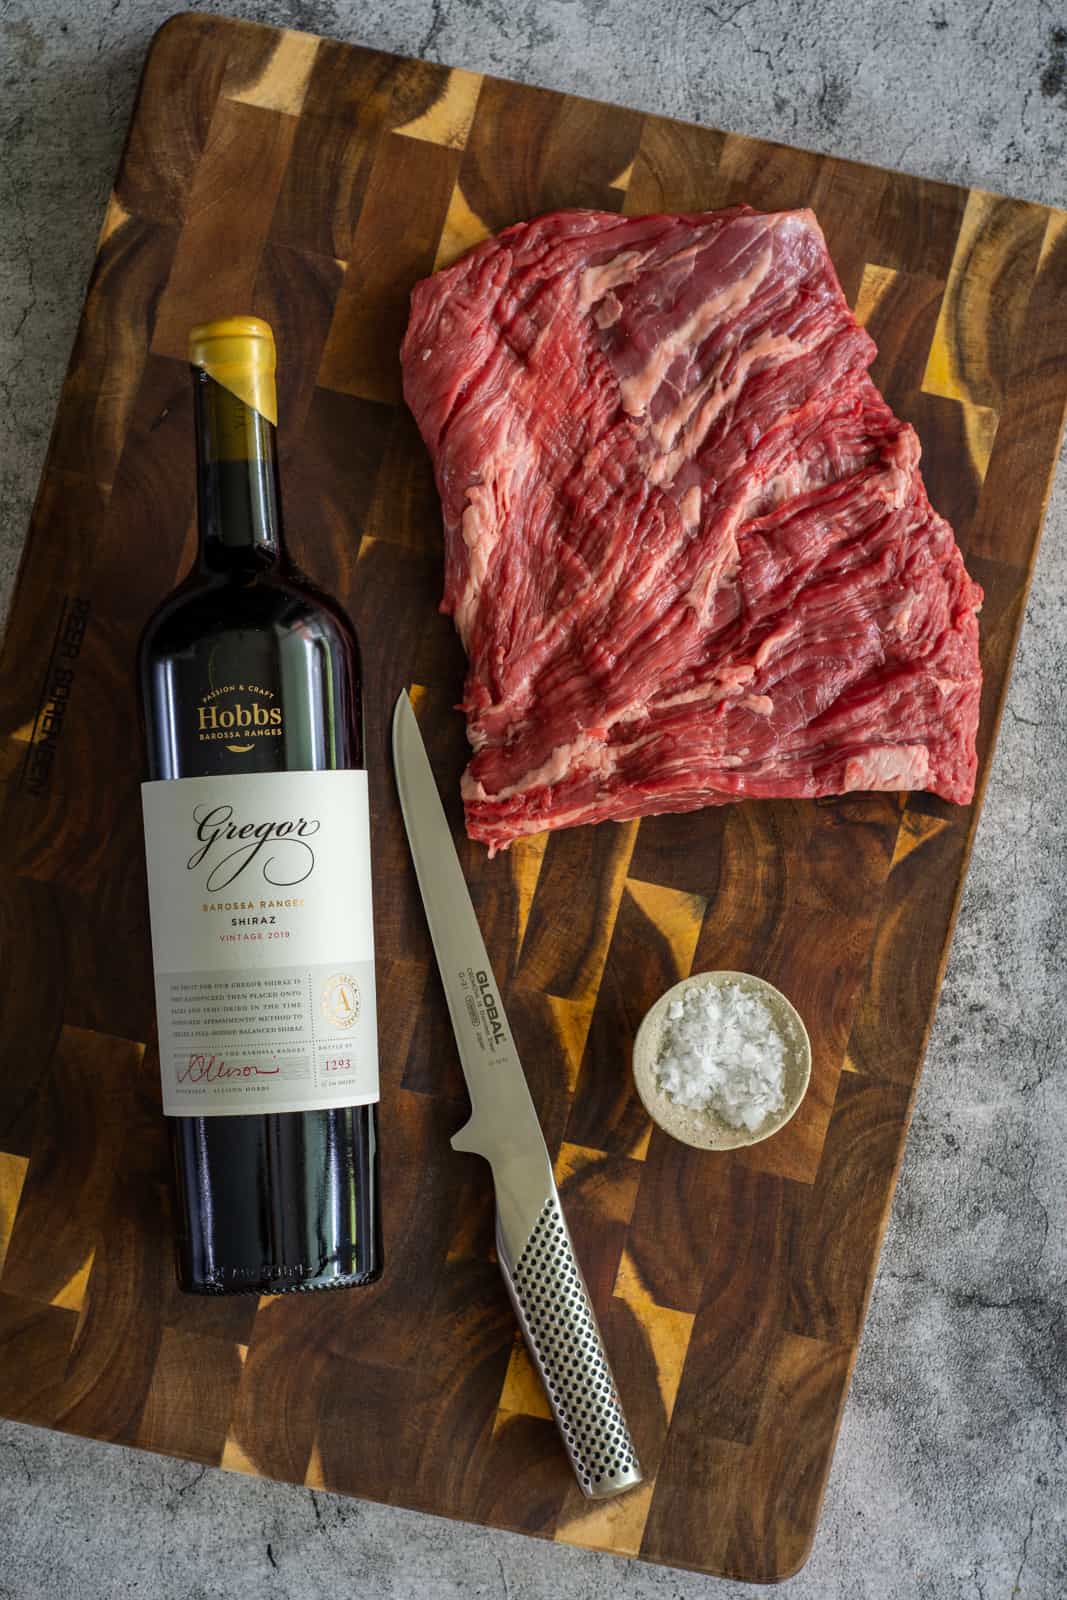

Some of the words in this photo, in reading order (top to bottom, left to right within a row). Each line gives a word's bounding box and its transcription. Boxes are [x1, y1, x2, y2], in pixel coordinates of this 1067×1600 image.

[203, 685, 235, 703] PASSION
[248, 685, 275, 699] CRAFT
[197, 703, 282, 730] Hobbs
[199, 731, 240, 741] BAROSSA
[244, 728, 282, 737] RANGES
[187, 802, 320, 892] Gregor
[203, 902, 255, 912] BAROSSA
[231, 915, 276, 926] SHIRAZ
[219, 932, 263, 942] VINTAGE
[475, 970, 505, 1045] GLOBAL
[325, 1058, 351, 1071] 1293
